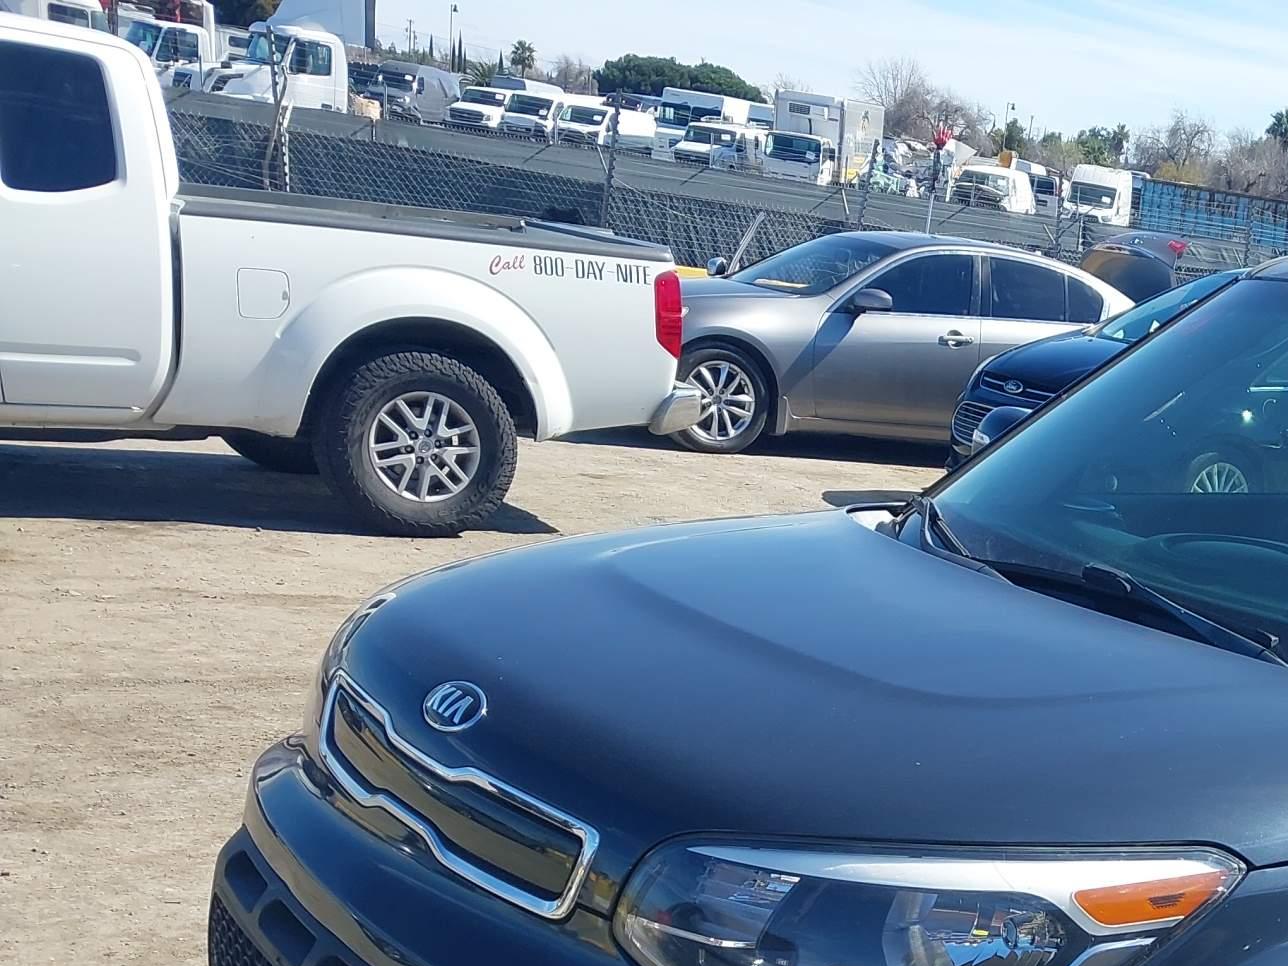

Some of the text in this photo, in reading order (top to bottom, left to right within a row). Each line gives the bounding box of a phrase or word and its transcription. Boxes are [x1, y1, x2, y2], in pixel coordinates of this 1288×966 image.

[489, 255, 651, 285] Call 800-DAY-NITE
[426, 684, 474, 724] KIA
